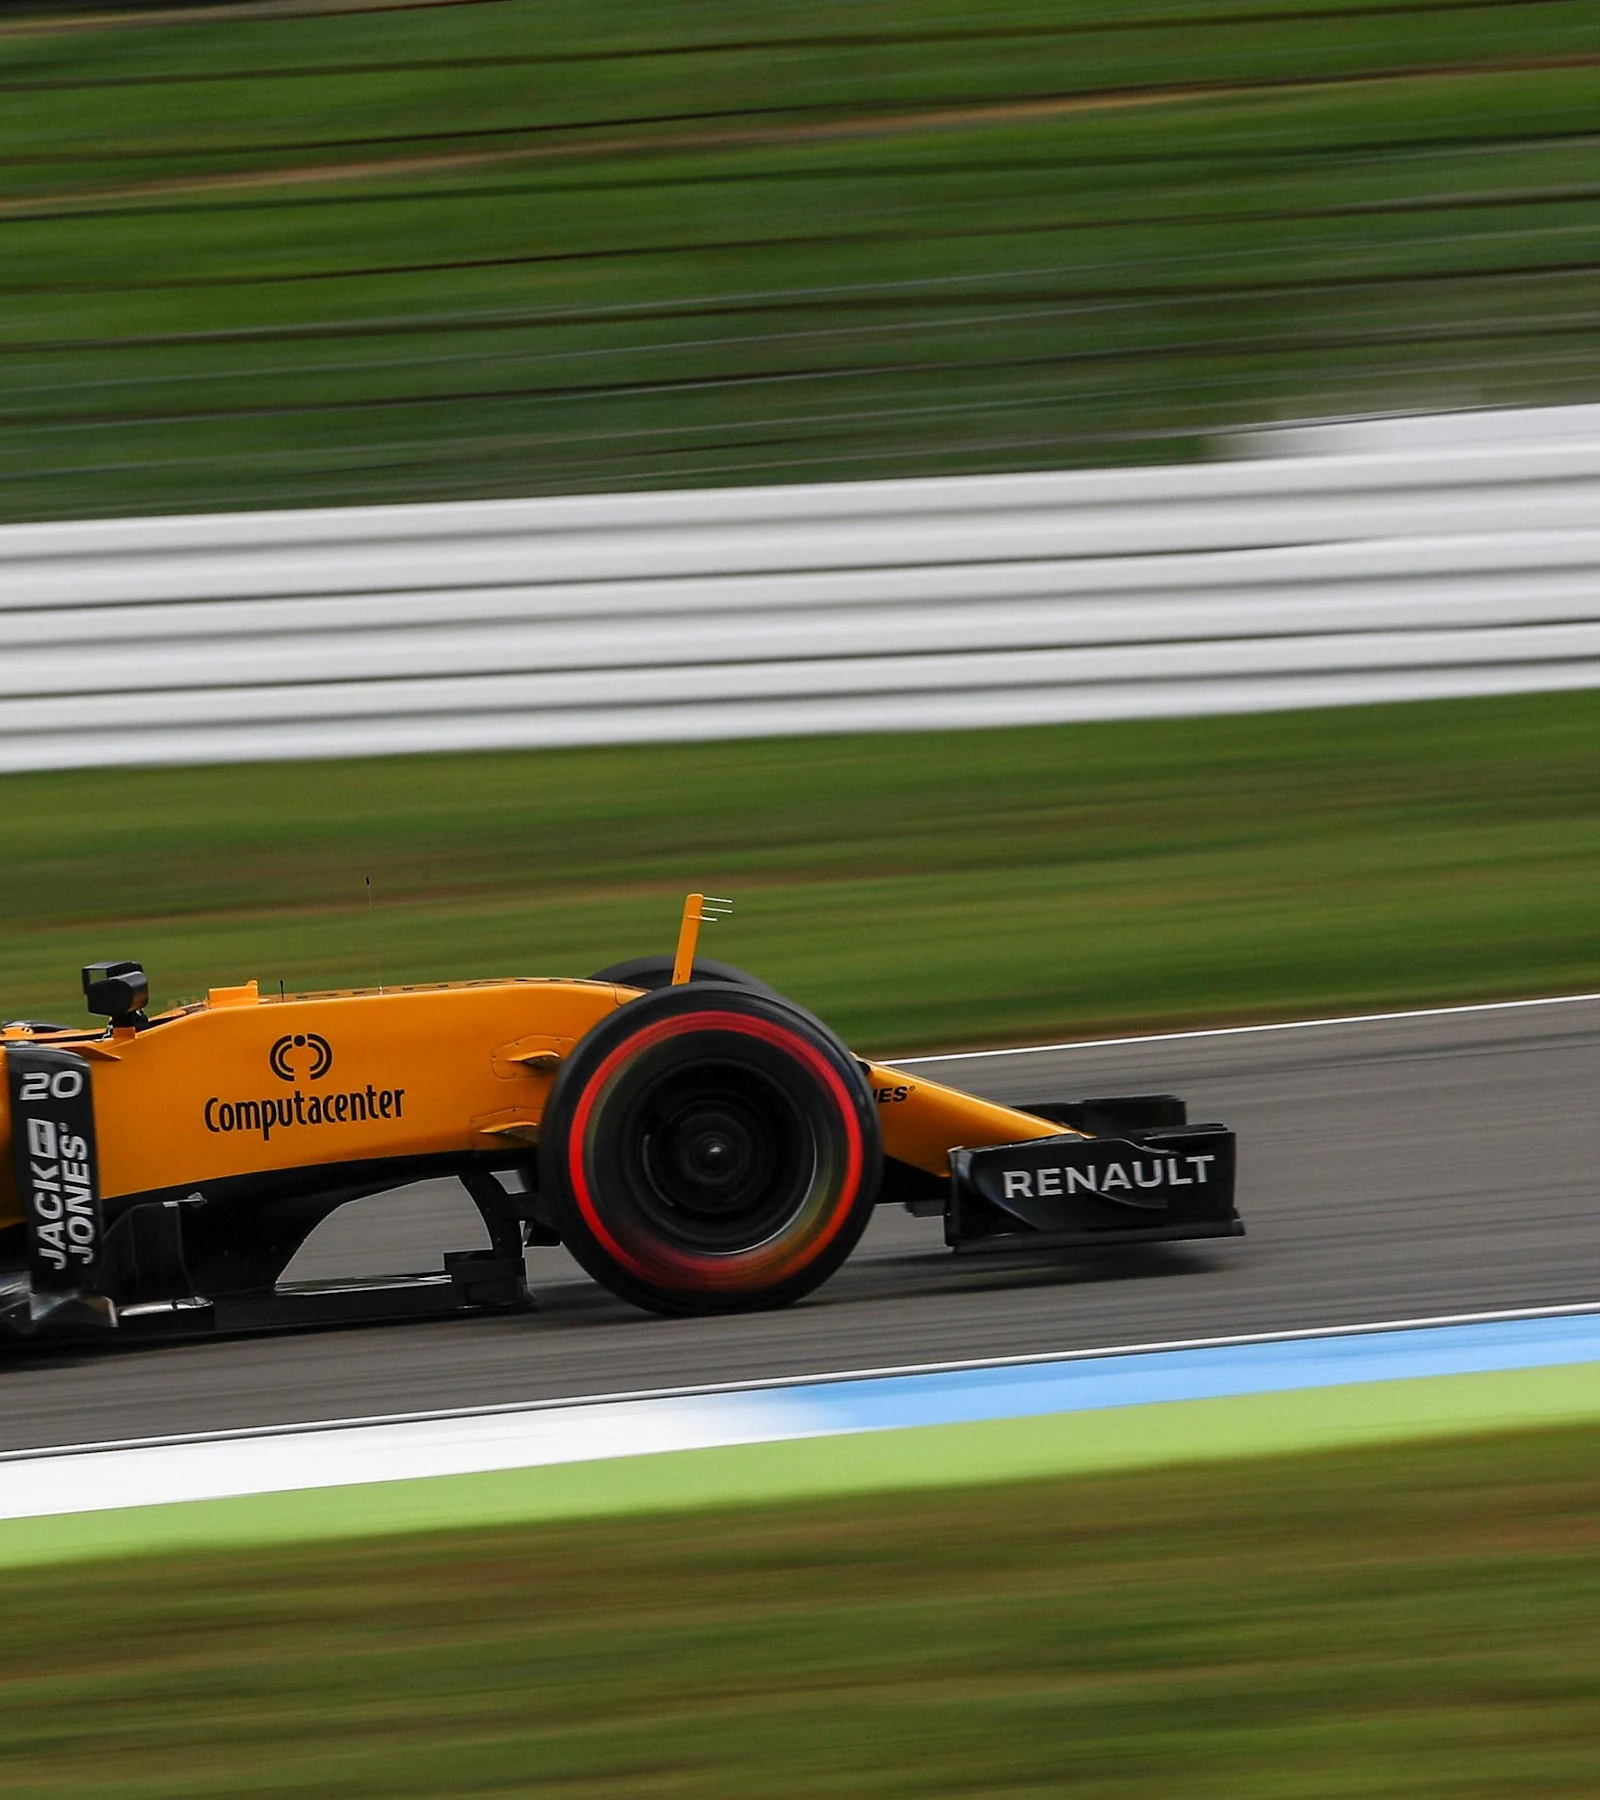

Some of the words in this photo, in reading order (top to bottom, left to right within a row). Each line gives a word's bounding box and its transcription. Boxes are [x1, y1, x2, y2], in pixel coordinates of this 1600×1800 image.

[20, 1070, 83, 1101] 20
[204, 1085, 405, 1141] Computacenter
[1002, 1154, 1215, 1199] RENAULT
[30, 1161, 67, 1270] JACK
